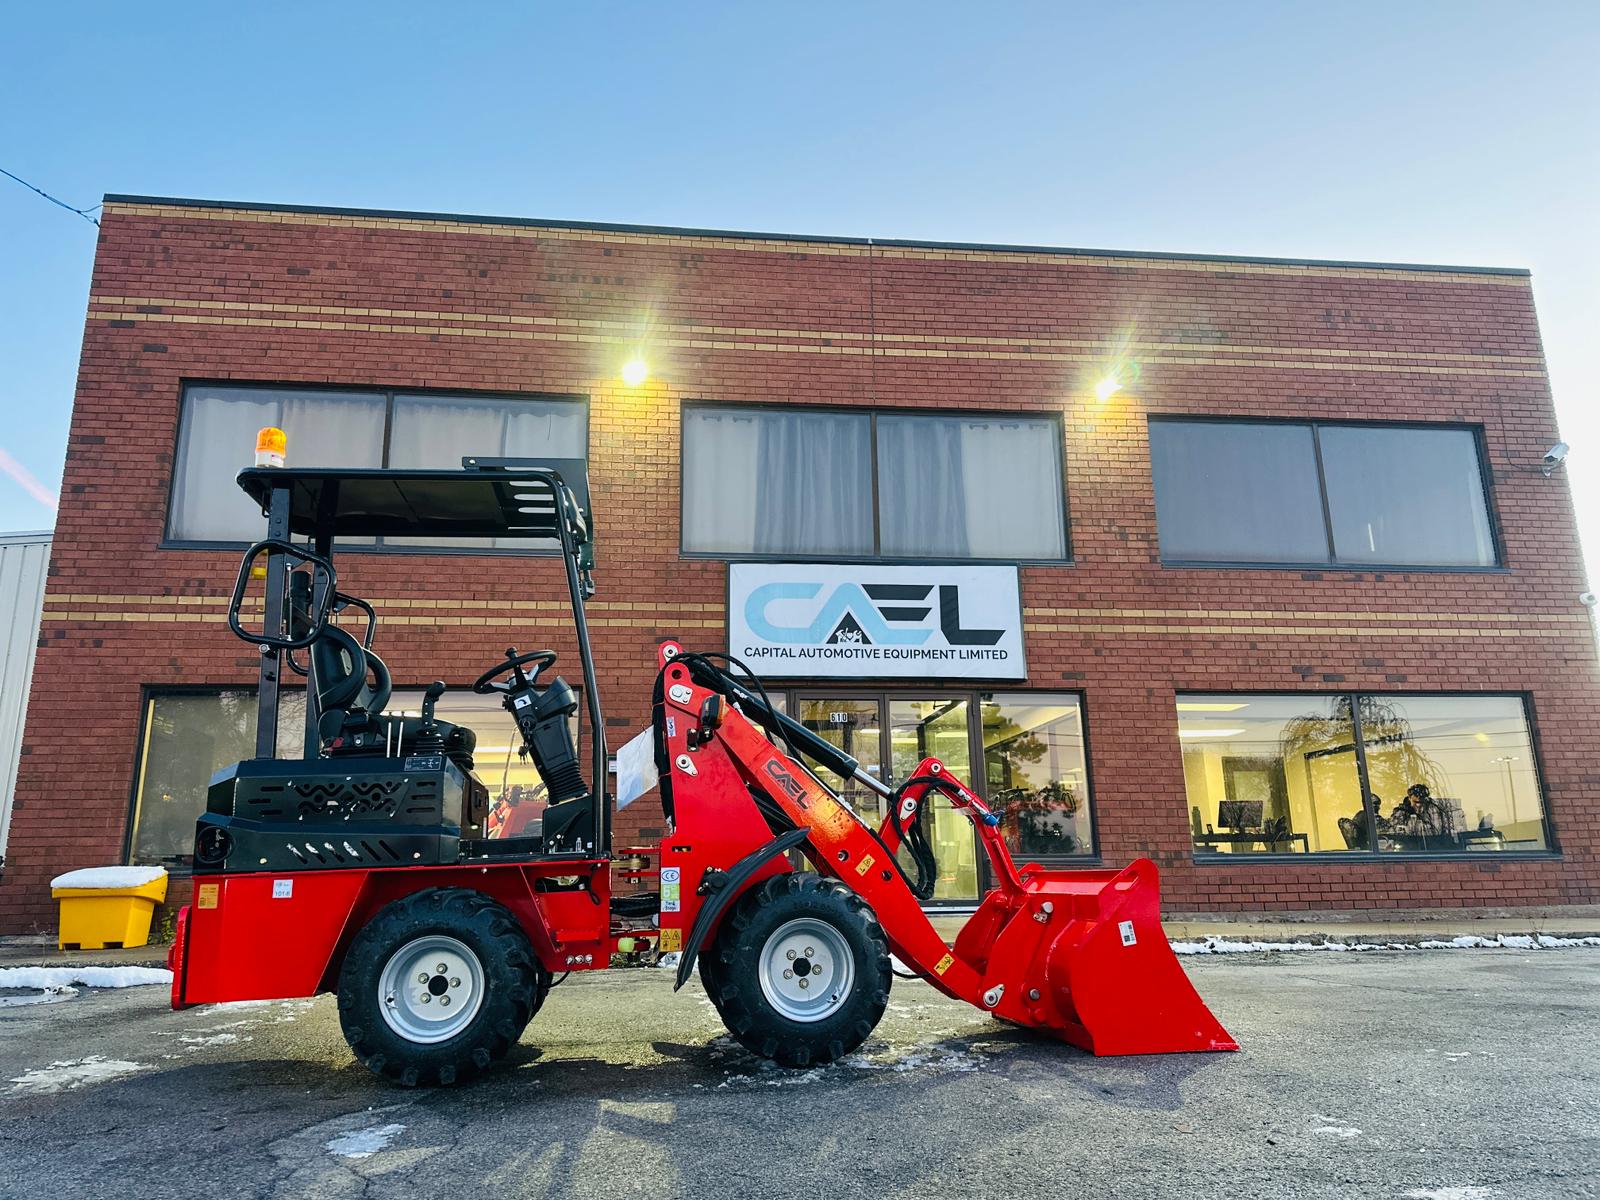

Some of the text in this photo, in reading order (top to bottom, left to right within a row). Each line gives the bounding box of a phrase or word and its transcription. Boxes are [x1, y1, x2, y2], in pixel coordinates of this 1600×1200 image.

[744, 582, 1006, 645] CAEL
[744, 647, 1008, 660] CAPITAL AUTOMOTIVE EQUIPMENT LIMITED
[831, 713, 847, 722] 610
[767, 760, 808, 809] CAEL
[665, 872, 675, 880] CE
